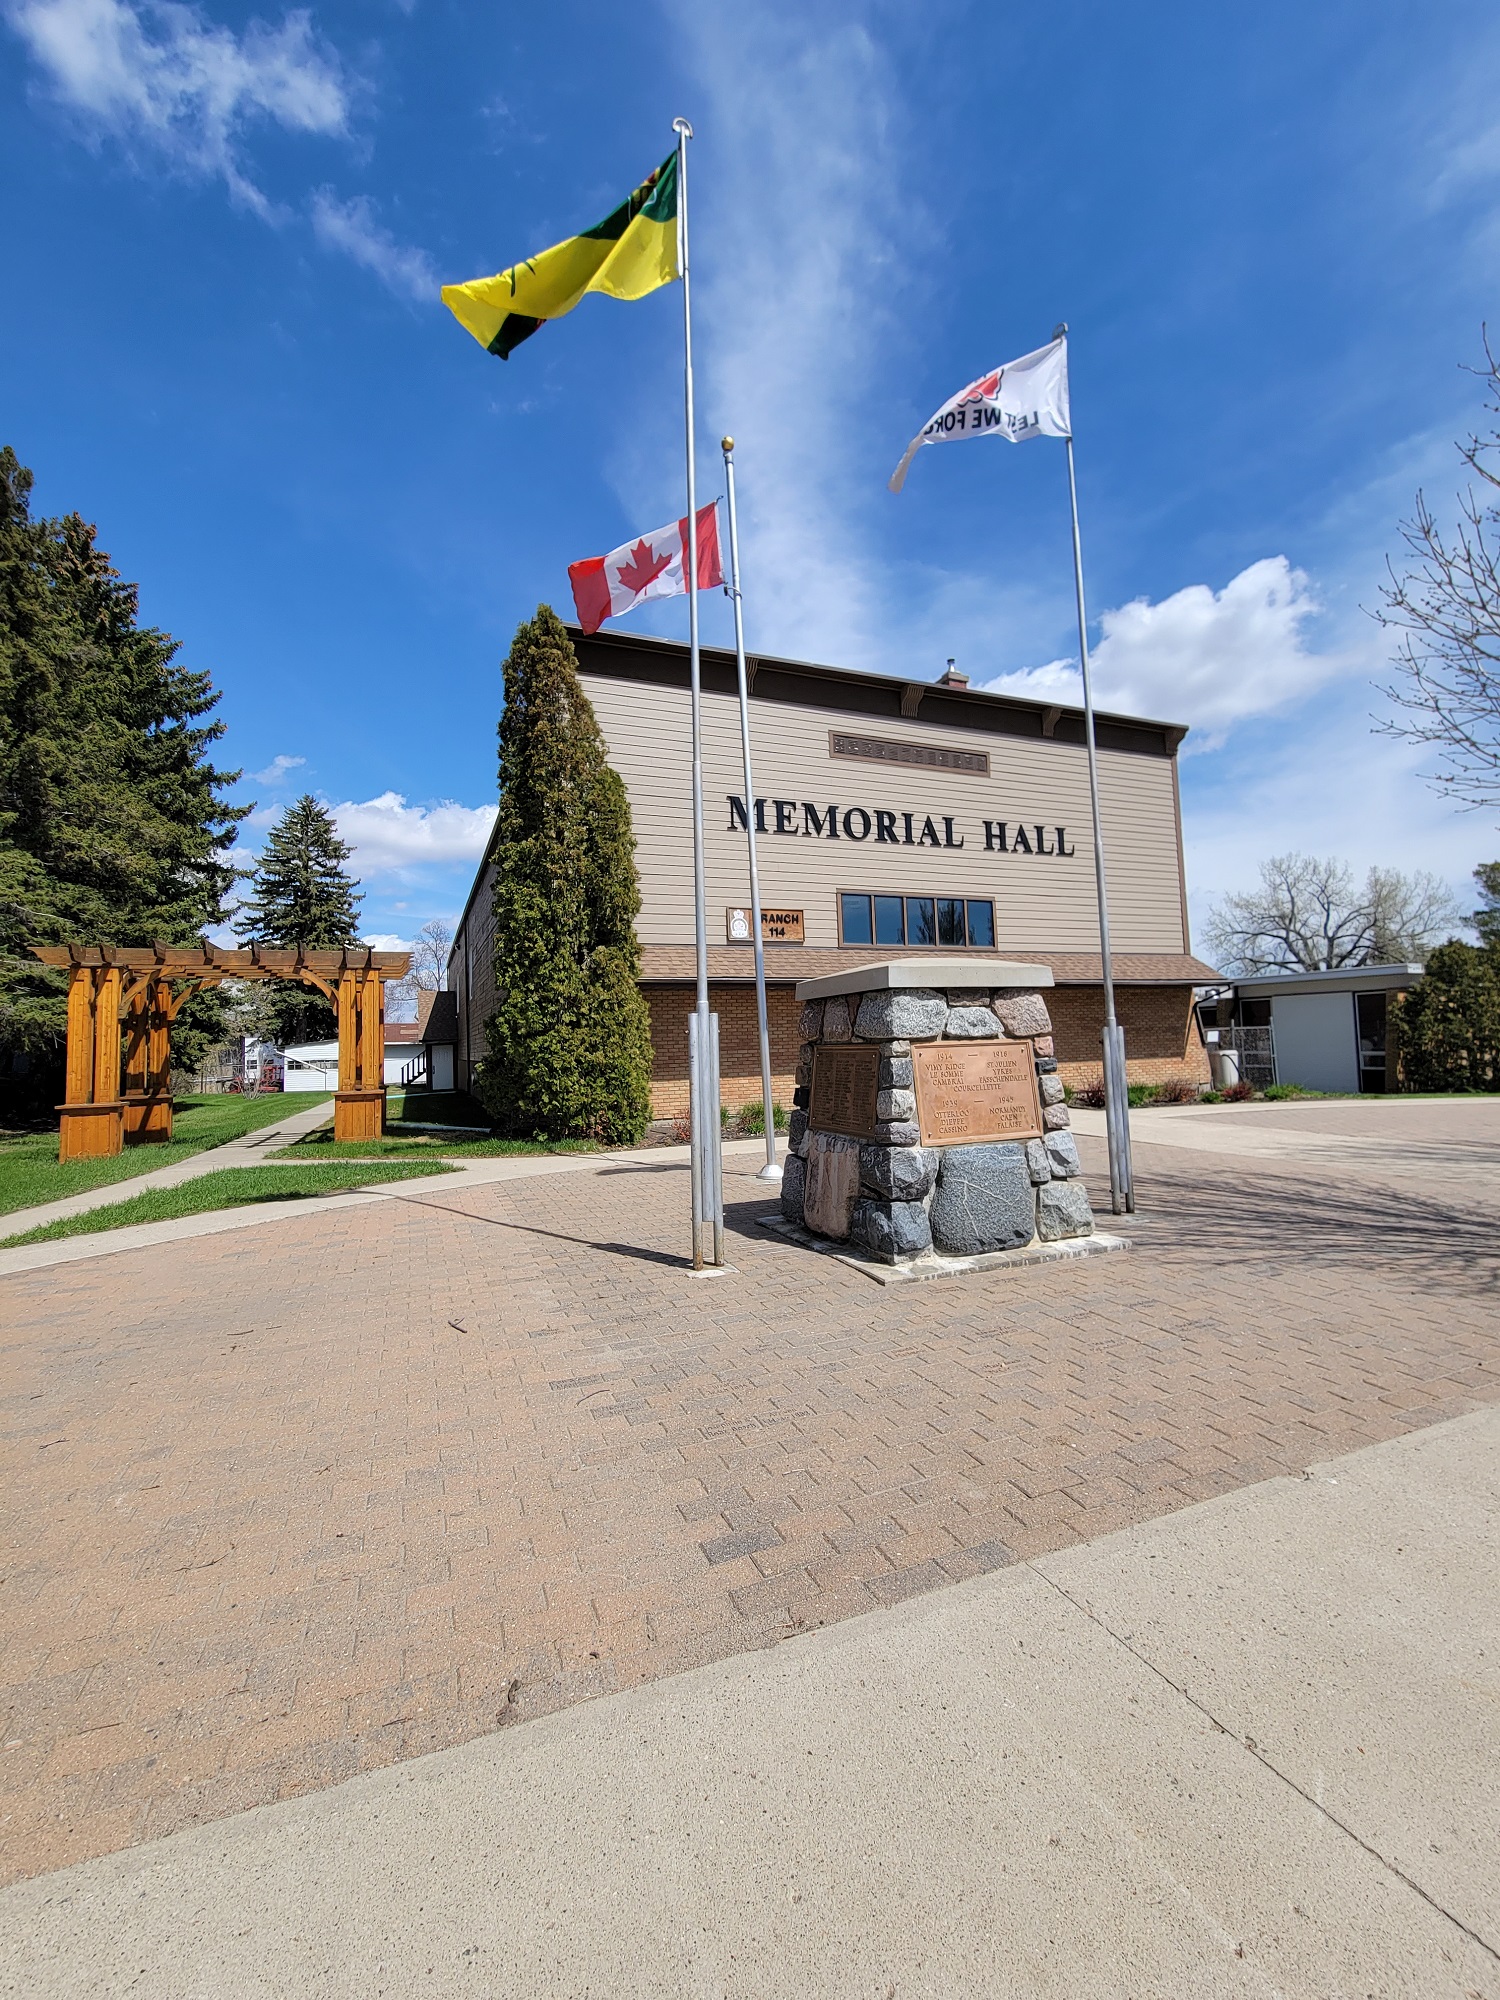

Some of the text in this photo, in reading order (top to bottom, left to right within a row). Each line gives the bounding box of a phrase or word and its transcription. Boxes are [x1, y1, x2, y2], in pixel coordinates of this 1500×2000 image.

[726, 796, 1074, 856] MEMORIAL HALL
[761, 914, 798, 925] RANCH
[769, 927, 785, 937] 114
[937, 1053, 953, 1061] 1914
[932, 1078, 964, 1086] CAMBRAI
[953, 1083, 1001, 1092] COURCELLETTE
[942, 1100, 958, 1108] 1939
[999, 1096, 1014, 1104] 1945
[934, 1110, 969, 1118] OTTERLOO
[989, 1106, 1026, 1115] NORMANDY
[997, 1121, 1022, 1129] FALAISE
